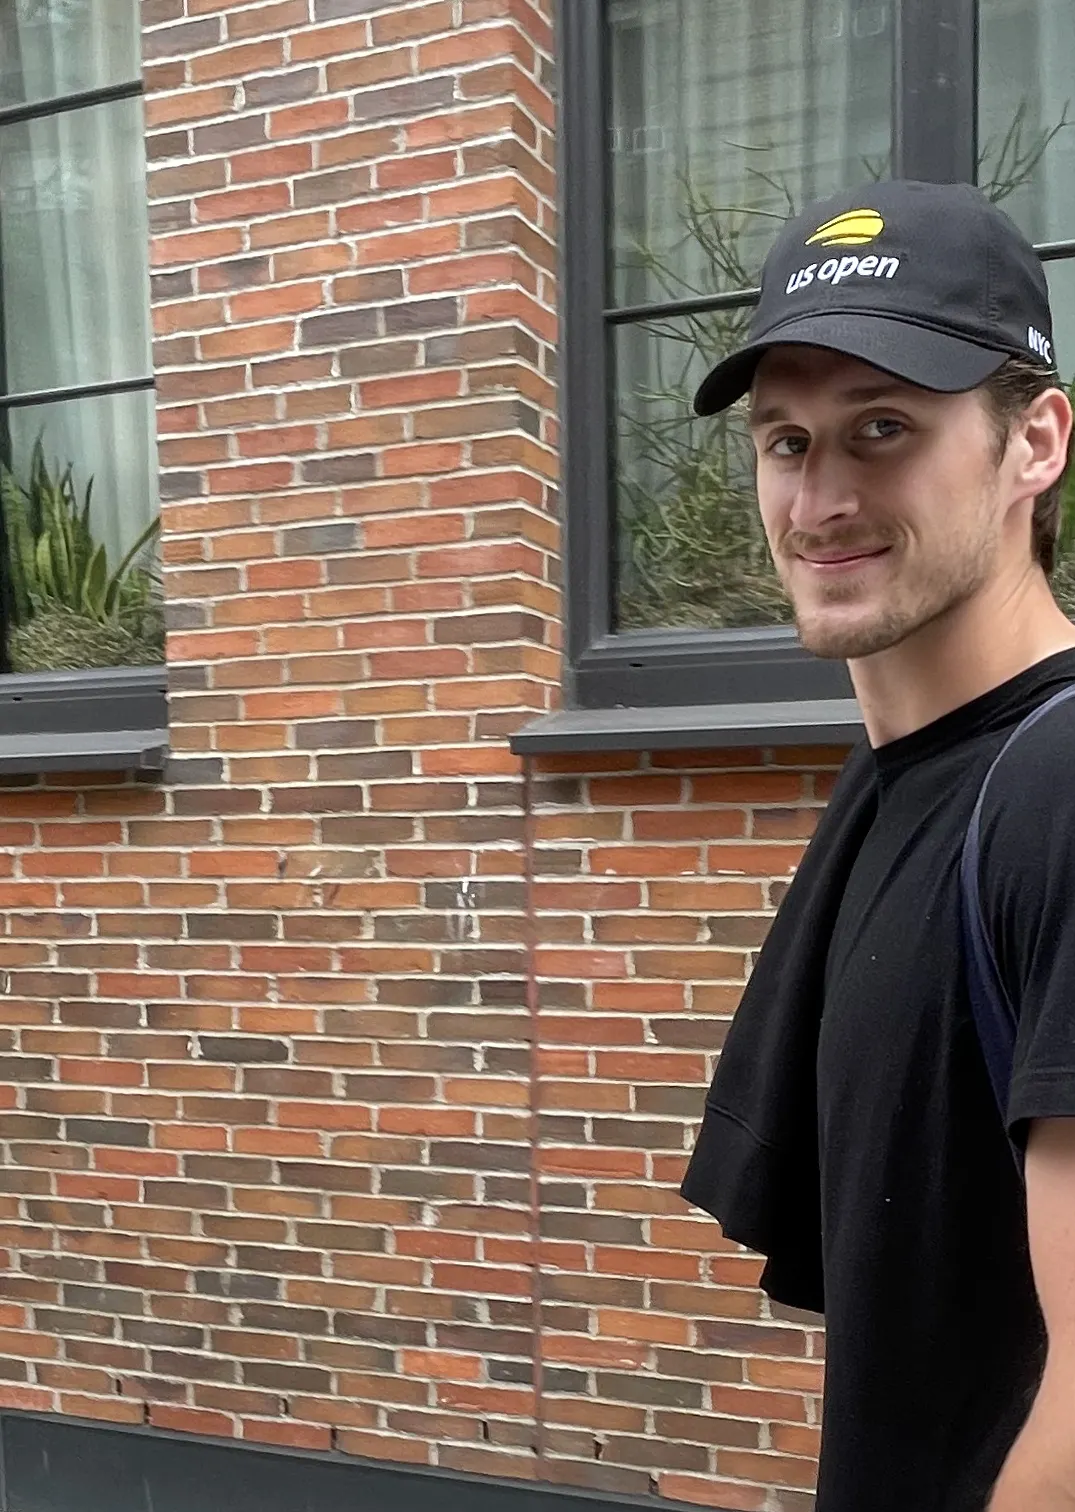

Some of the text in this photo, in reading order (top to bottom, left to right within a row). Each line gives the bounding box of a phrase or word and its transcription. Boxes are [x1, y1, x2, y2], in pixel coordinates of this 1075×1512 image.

[786, 255, 900, 294] us open
[1028, 326, 1052, 364] NYC
